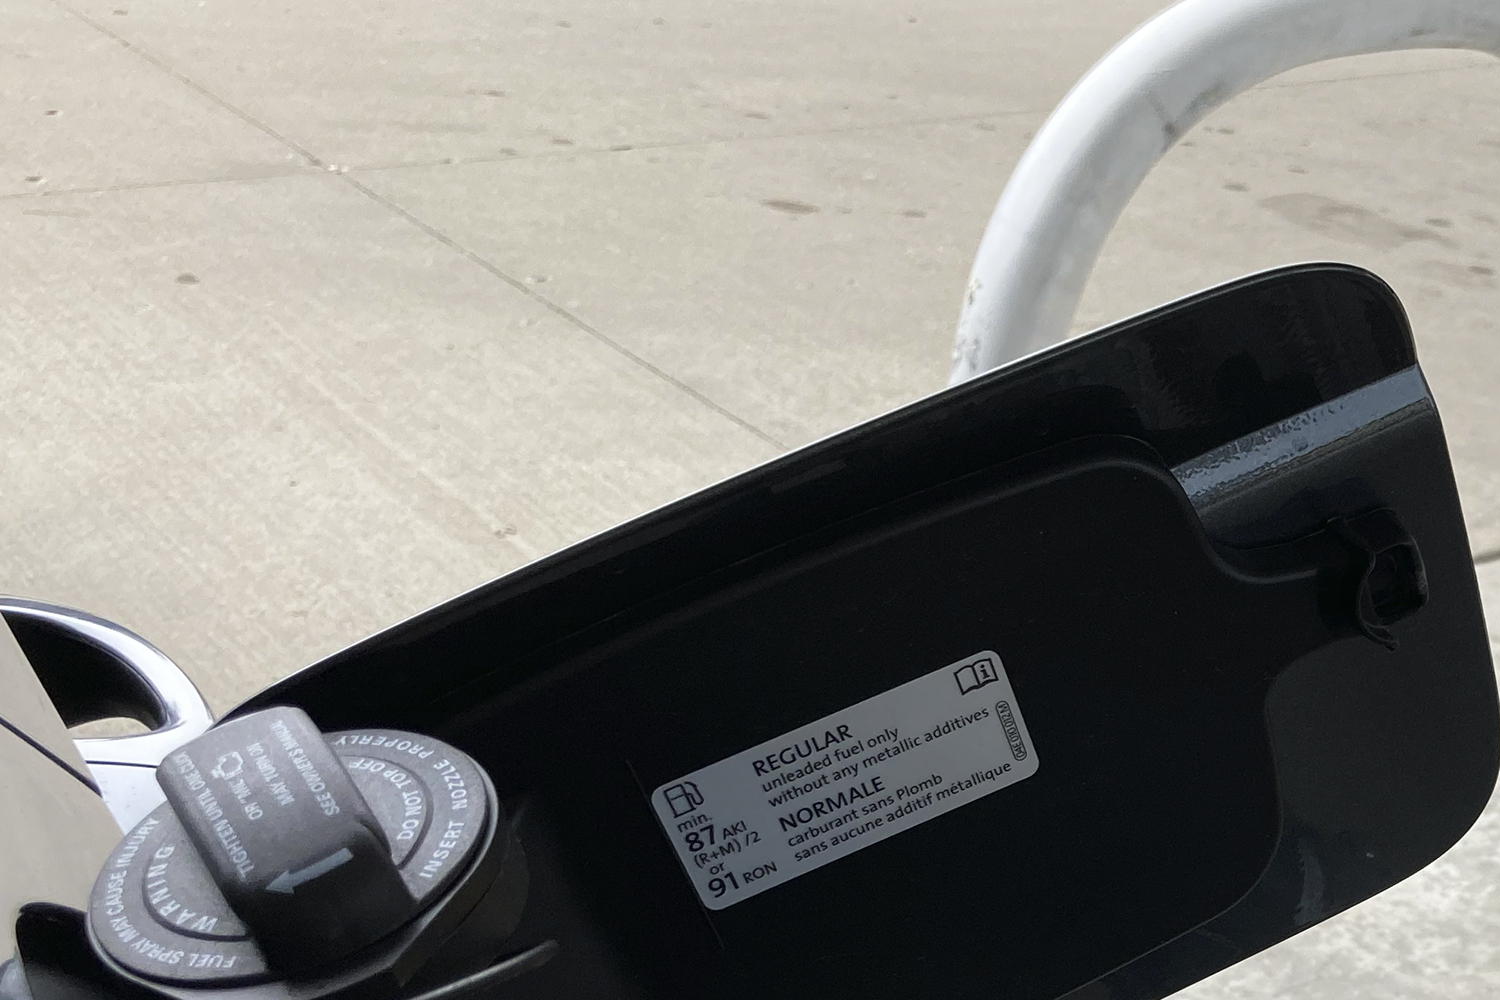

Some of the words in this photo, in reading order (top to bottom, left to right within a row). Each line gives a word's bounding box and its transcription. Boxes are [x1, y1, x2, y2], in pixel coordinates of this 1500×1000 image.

[246, 742, 263, 757] ON
[270, 719, 299, 750] MANUAL
[334, 734, 435, 760] PROPERLY
[349, 758, 386, 773] OFF
[752, 724, 853, 777] REGULAR
[762, 754, 832, 793] unleaded
[833, 740, 865, 762] fuel
[867, 728, 898, 749] only
[768, 774, 830, 807] without
[834, 763, 858, 778] any
[862, 735, 922, 769] metallic
[924, 707, 990, 742] additives
[183, 772, 206, 791] ONE
[254, 755, 280, 783] TURN
[383, 769, 412, 789] TOP
[433, 759, 468, 810] NOZZLE
[199, 788, 223, 822] UNTIL
[269, 781, 295, 806] MAY
[316, 791, 340, 816] SEE
[402, 790, 423, 815] NOT
[778, 776, 885, 832] NORMALE
[244, 801, 264, 821] OR
[677, 813, 712, 833] min.
[788, 809, 860, 847] carburant
[861, 795, 894, 816] sans
[896, 773, 943, 801] Plomb
[794, 841, 828, 862] sans
[831, 817, 884, 846] aucune
[886, 793, 933, 823] additif
[936, 762, 1012, 802] métallique
[115, 817, 160, 868] INJURY
[397, 818, 420, 841] DO
[685, 824, 715, 852] 87
[722, 820, 747, 840] AKI
[214, 819, 255, 880] TIGHTEN
[419, 820, 465, 879] INSERT
[694, 838, 742, 869] (R+M)
[745, 831, 761, 847] /2
[708, 872, 739, 898] 91
[742, 861, 777, 884] RON
[710, 862, 725, 875] or
[105, 870, 128, 916] CAUSE
[147, 845, 219, 933] WARNING
[109, 915, 141, 943] MAY
[131, 937, 185, 964] SPRAY
[188, 953, 237, 969] FUEL
